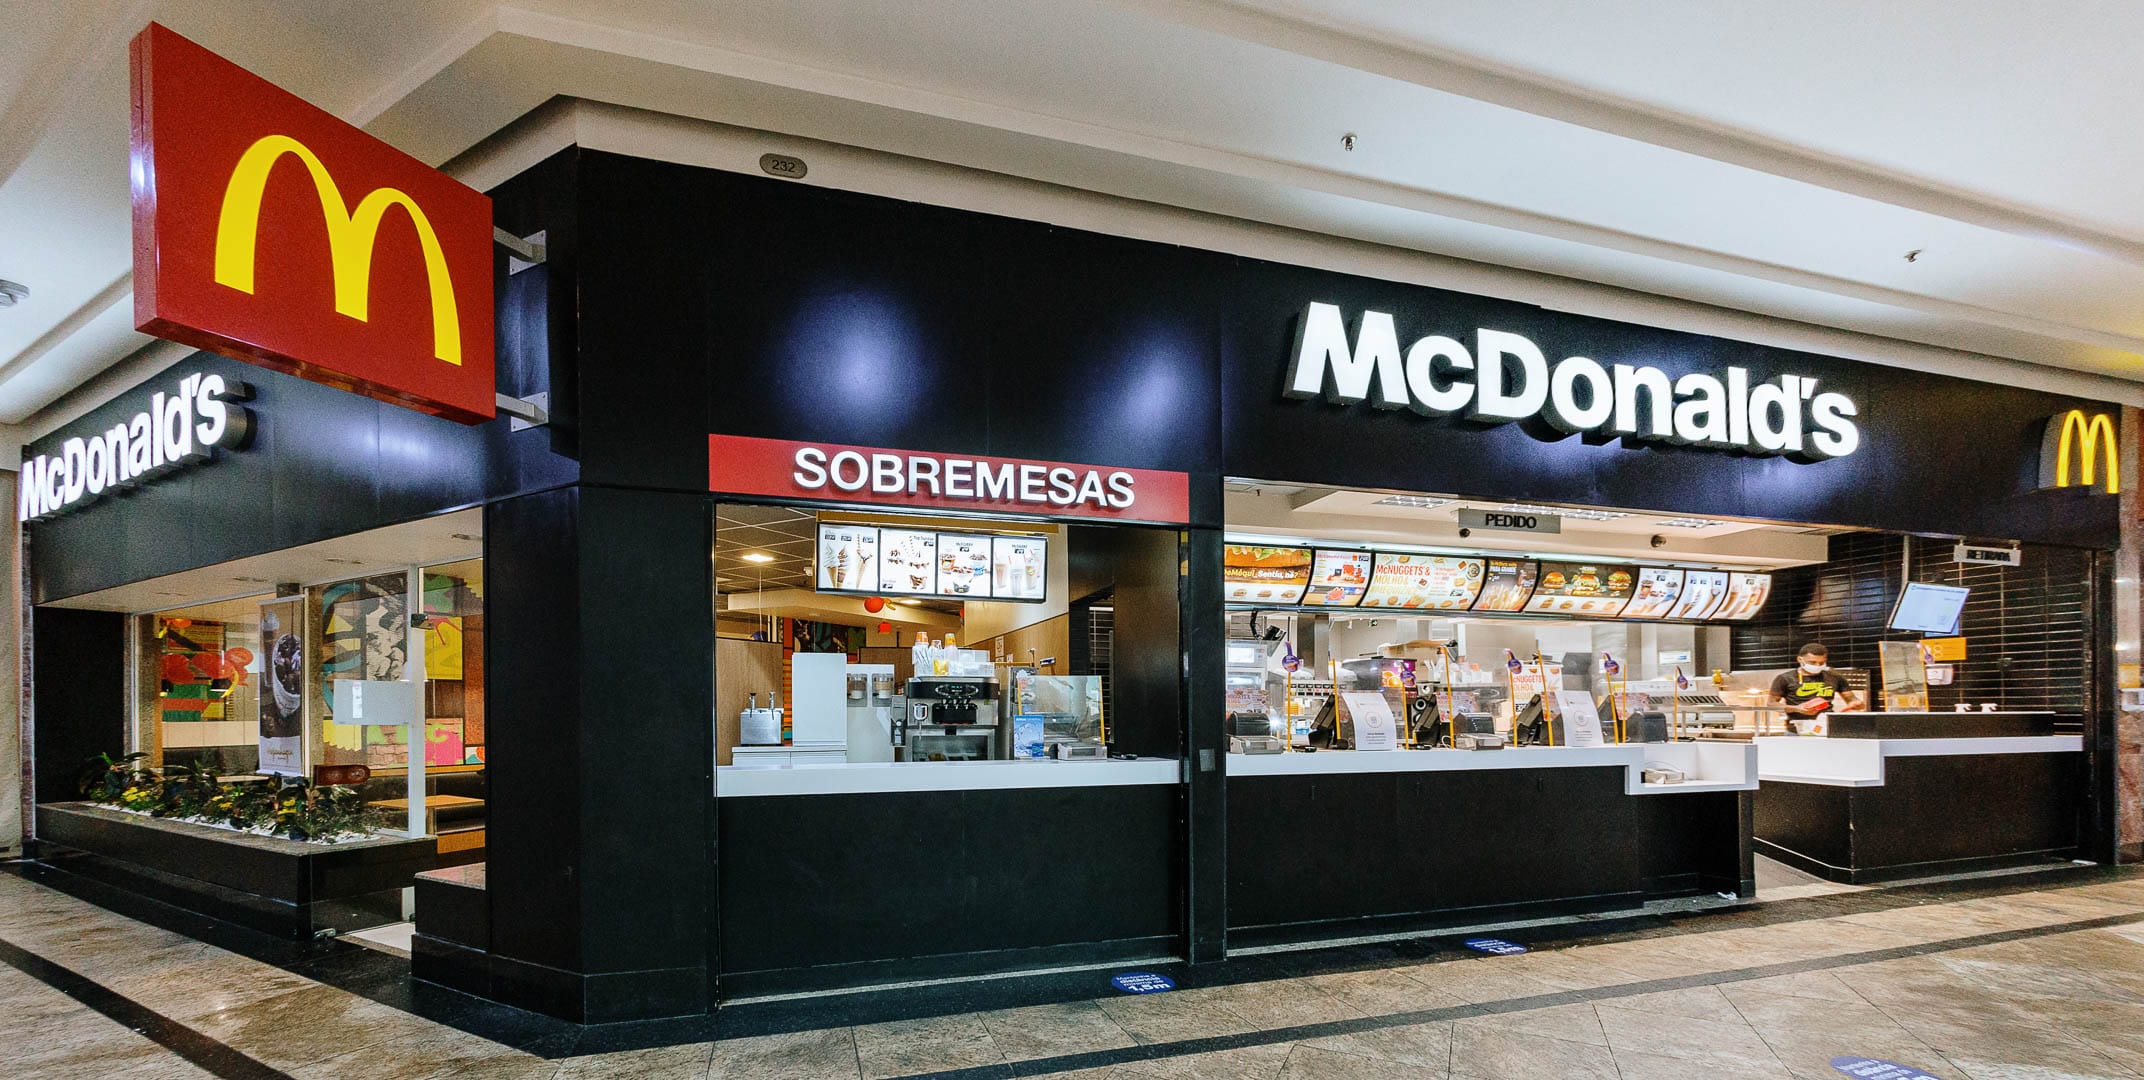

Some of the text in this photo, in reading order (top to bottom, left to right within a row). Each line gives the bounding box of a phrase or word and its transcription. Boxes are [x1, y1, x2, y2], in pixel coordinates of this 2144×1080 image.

[771, 159, 796, 173] 232
[1293, 301, 1860, 457] McDonald's
[18, 372, 227, 522] McDonald's
[794, 447, 1135, 508] SOBREMESAS
[1485, 513, 1538, 529] PEDIDO
[1375, 564, 1423, 576] McNUGGETS
[1128, 983, 1170, 991] 1,5m
